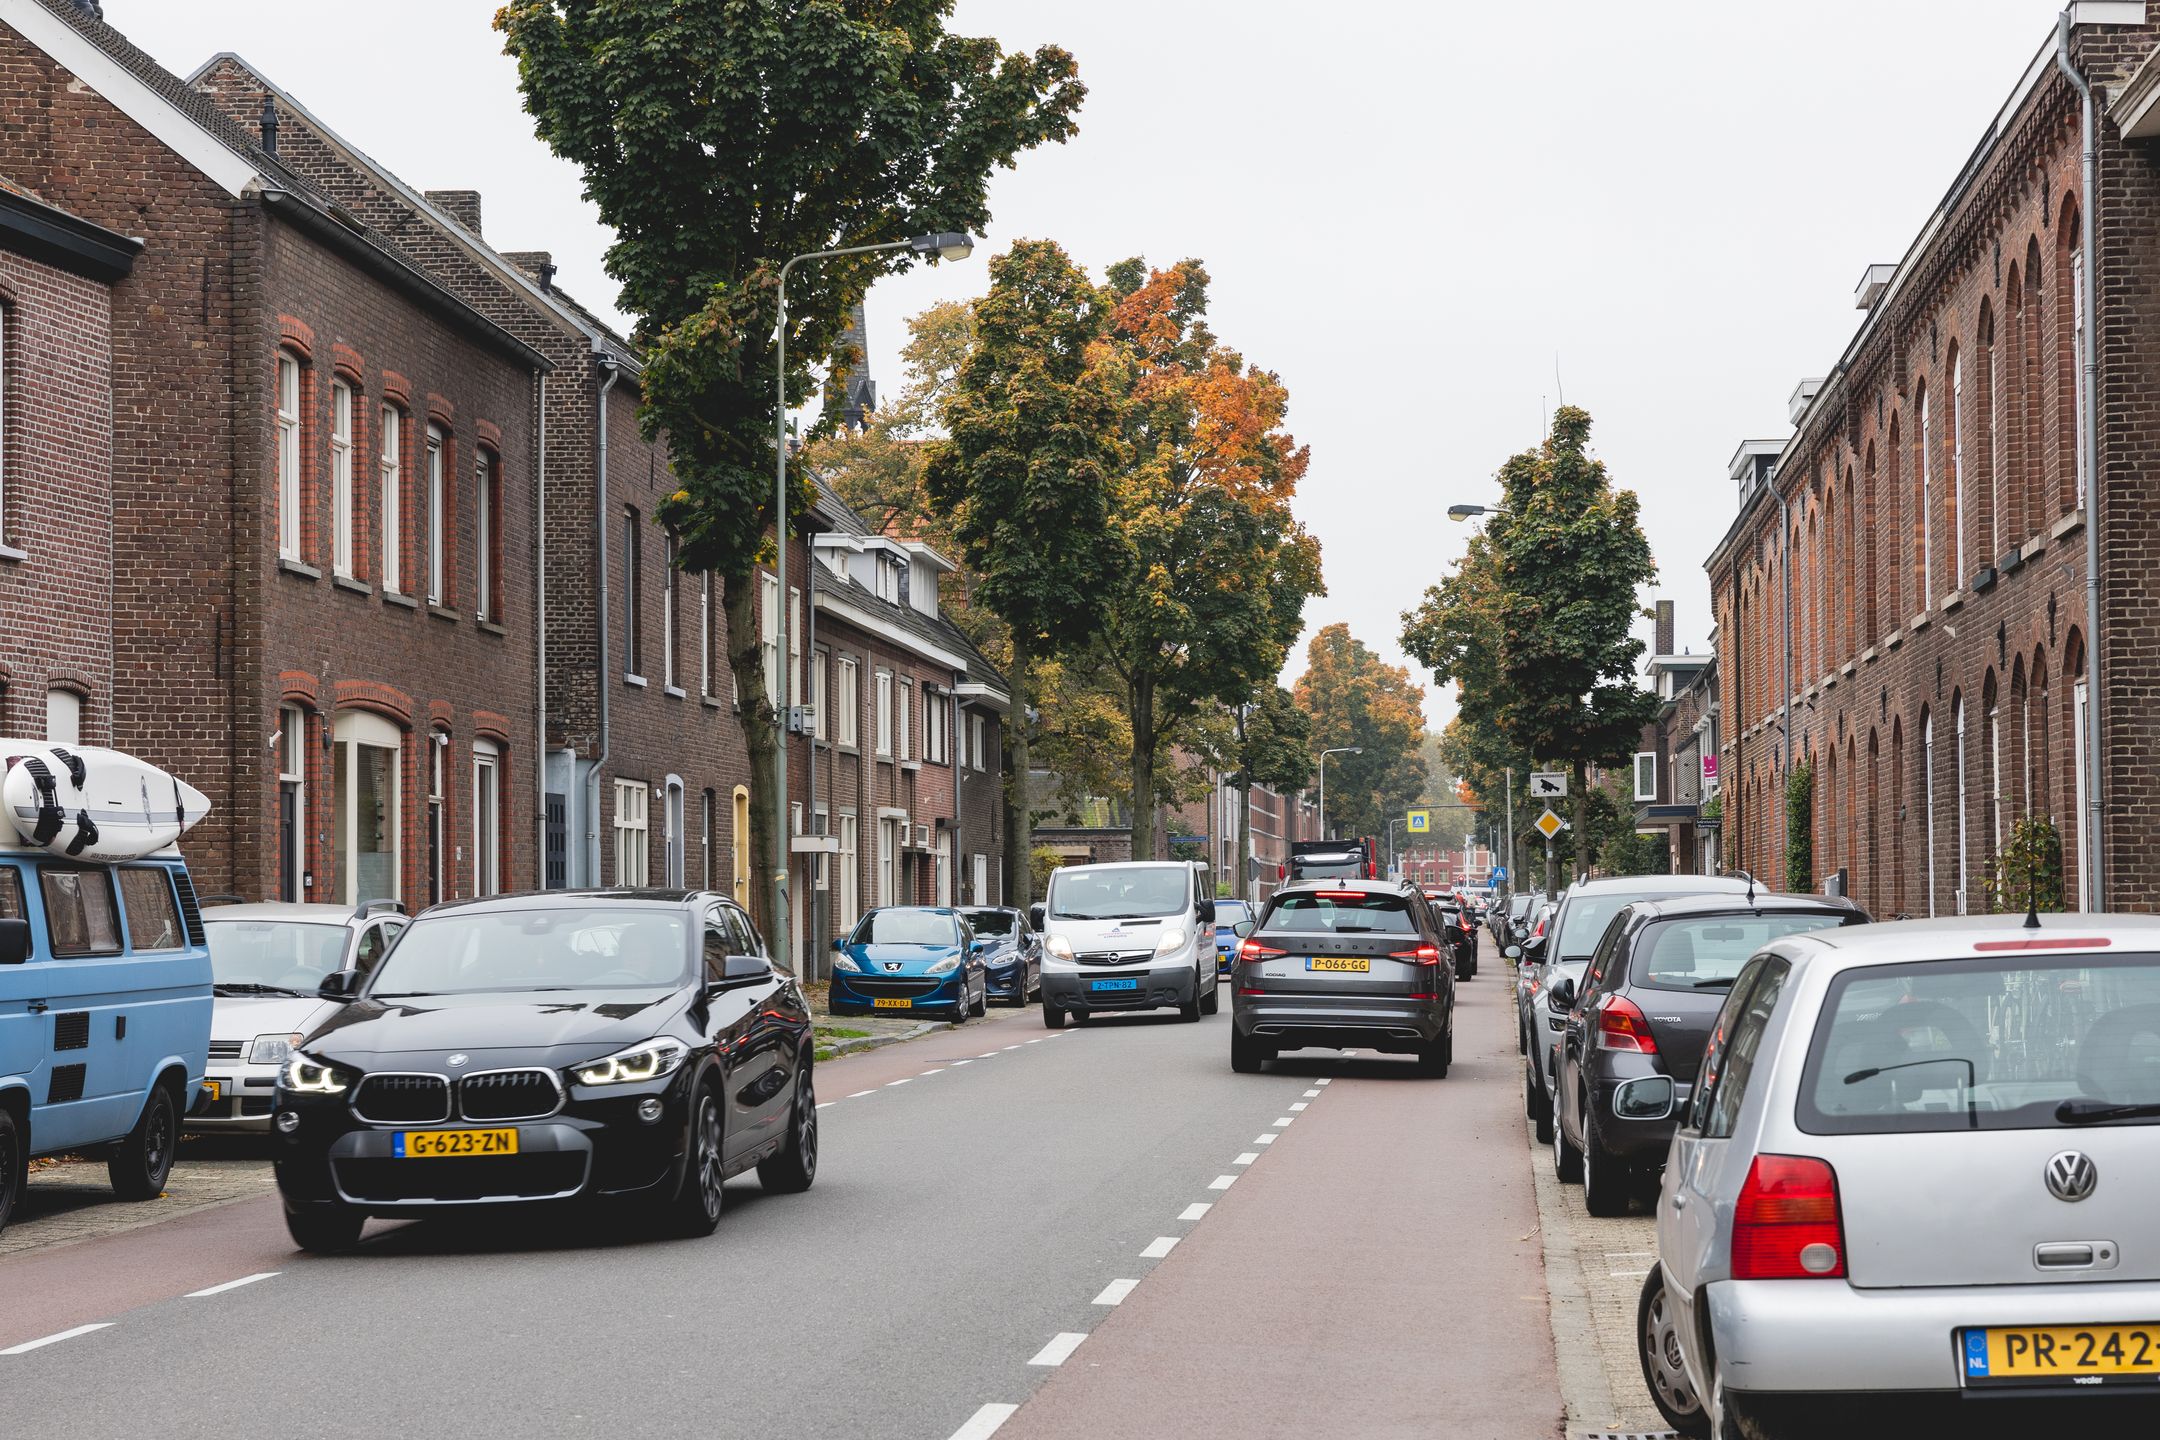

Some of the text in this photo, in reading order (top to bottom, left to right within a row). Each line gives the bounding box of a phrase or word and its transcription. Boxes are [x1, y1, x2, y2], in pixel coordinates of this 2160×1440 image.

[1314, 959, 1366, 970] P-066-GG
[1097, 981, 1133, 990] 2-TPN-82
[876, 1000, 910, 1008] 79-XX-DJ
[413, 1134, 510, 1154] G-623-ZN
[2045, 1150, 2098, 1203] VW
[1968, 1357, 1987, 1369] NL
